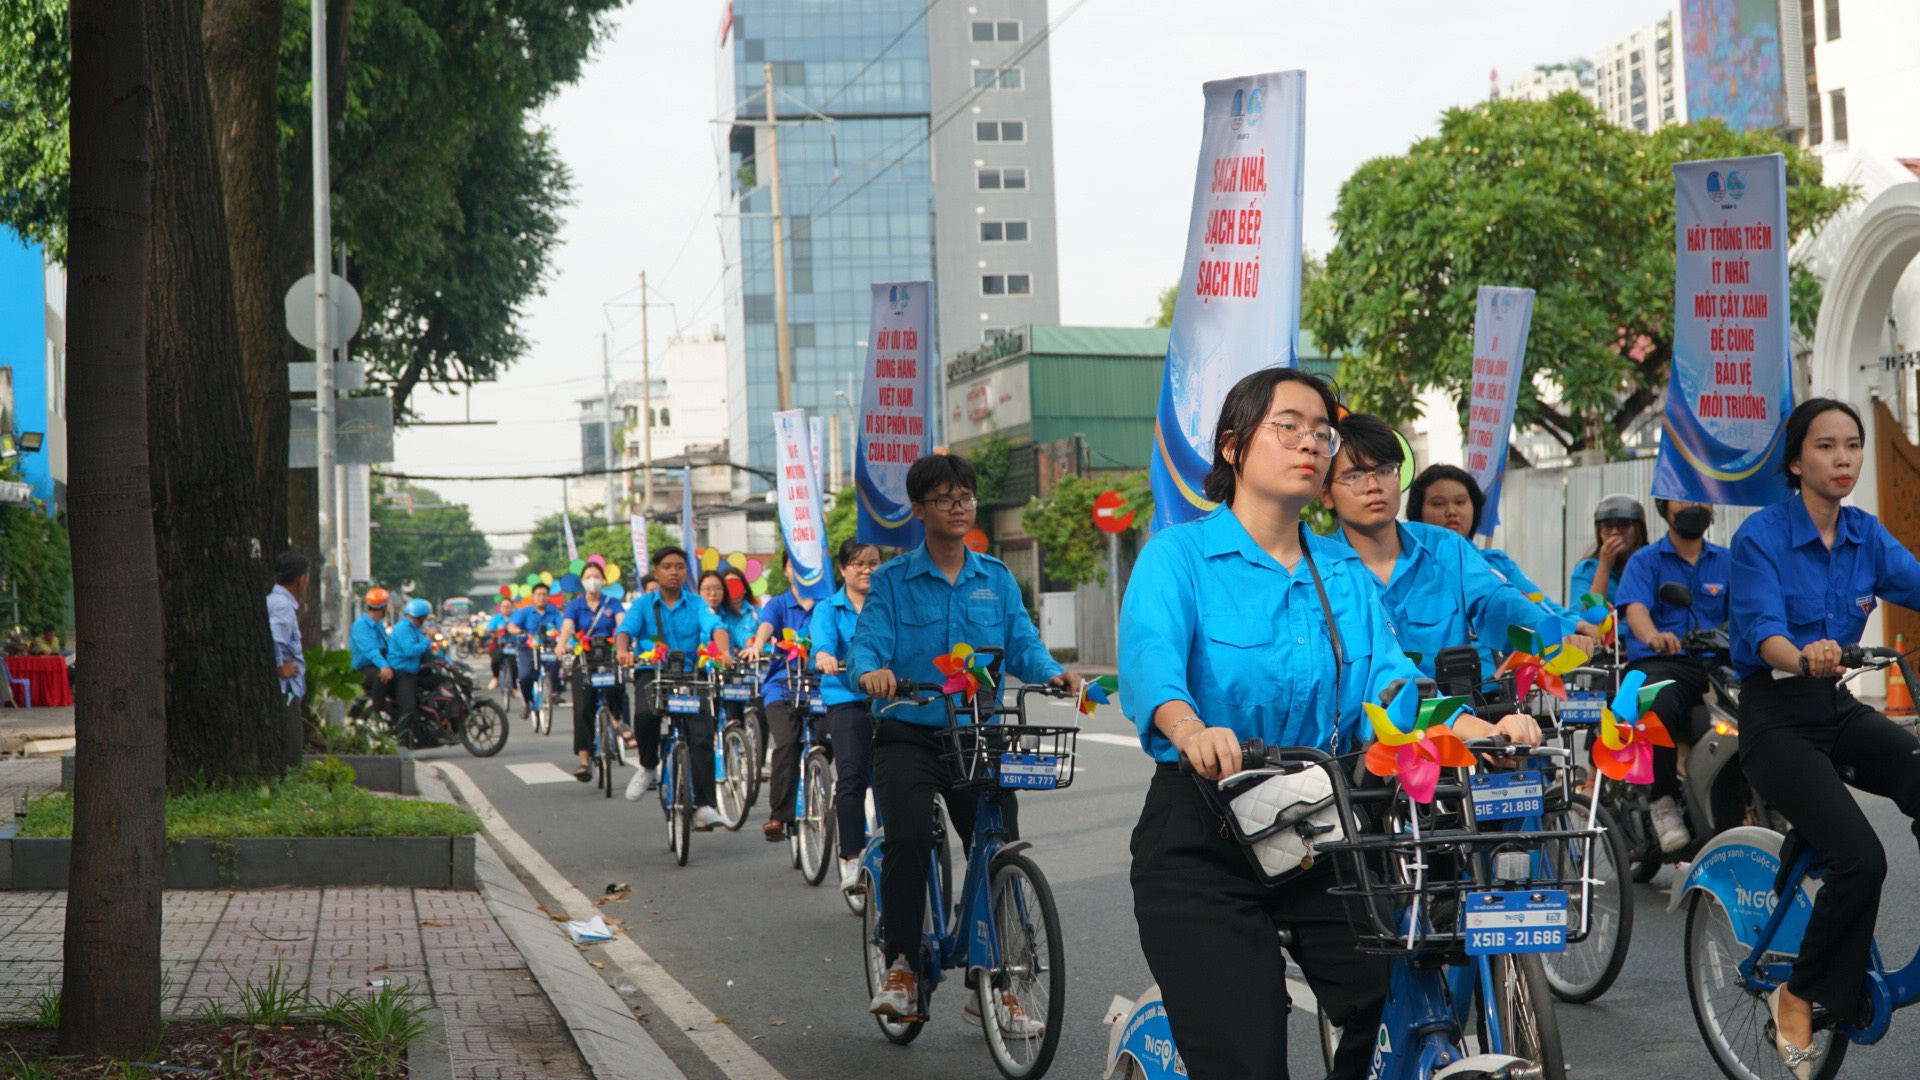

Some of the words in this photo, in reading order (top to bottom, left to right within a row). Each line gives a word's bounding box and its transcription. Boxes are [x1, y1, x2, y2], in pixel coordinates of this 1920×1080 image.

[1211, 157, 1239, 200] SẠCH
[1205, 209, 1236, 252] SẠCH
[1238, 198, 1262, 249] BẾP,
[1687, 223, 1707, 251] HÃY
[1710, 219, 1742, 251] TRỒNG
[1744, 221, 1772, 250] THÊM
[1197, 260, 1231, 304] SẠCH
[1233, 255, 1260, 298] NGÕ
[1712, 256, 1722, 284] ÍT
[1725, 252, 1750, 284] NHẤT
[1695, 289, 1717, 323] MỘT
[1720, 289, 1740, 318] CÂY
[1742, 294, 1768, 318] XANH
[877, 327, 890, 350] HÃY
[903, 326, 918, 350] TIÊN
[1727, 323, 1755, 352] CÙNG
[876, 355, 896, 378] DÙNG
[1716, 353, 1737, 385] BẢO
[1739, 357, 1752, 389] VỆ
[879, 382, 895, 411] VIỆT
[897, 387, 914, 407] NAM
[1699, 389, 1723, 418] MÔI
[1725, 387, 1766, 420] TRƯỜNG
[866, 410, 873, 434] VÌ
[875, 412, 886, 439] SỰ
[909, 416, 923, 437] VINH
[869, 436, 885, 462] CỦA
[887, 437, 901, 463] ĐẤT
[1727, 848, 1744, 858] xanh
[1751, 851, 1771, 868] Cuộc
